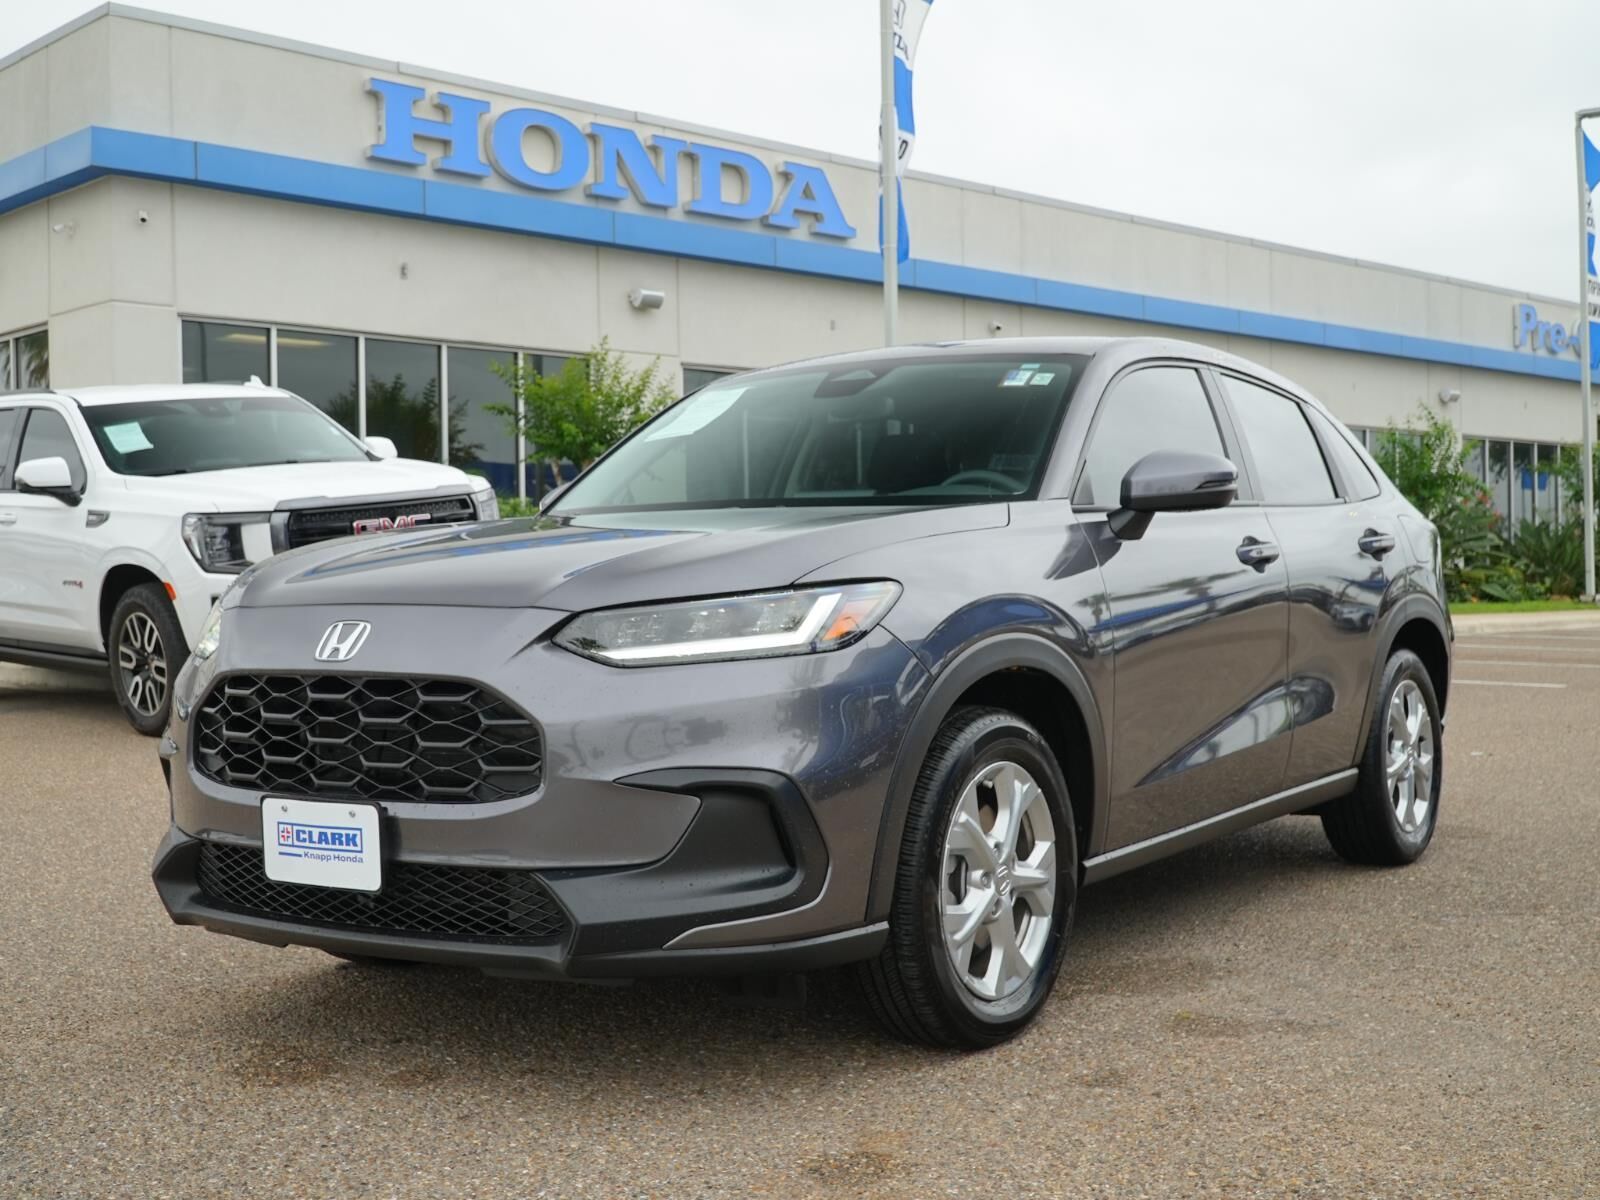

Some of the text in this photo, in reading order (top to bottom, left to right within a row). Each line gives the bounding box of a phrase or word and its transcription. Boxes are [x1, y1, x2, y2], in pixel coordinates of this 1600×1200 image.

[365, 77, 857, 240] HONDA
[295, 829, 358, 847] CLARK
[303, 851, 364, 863] Knapp Honda
